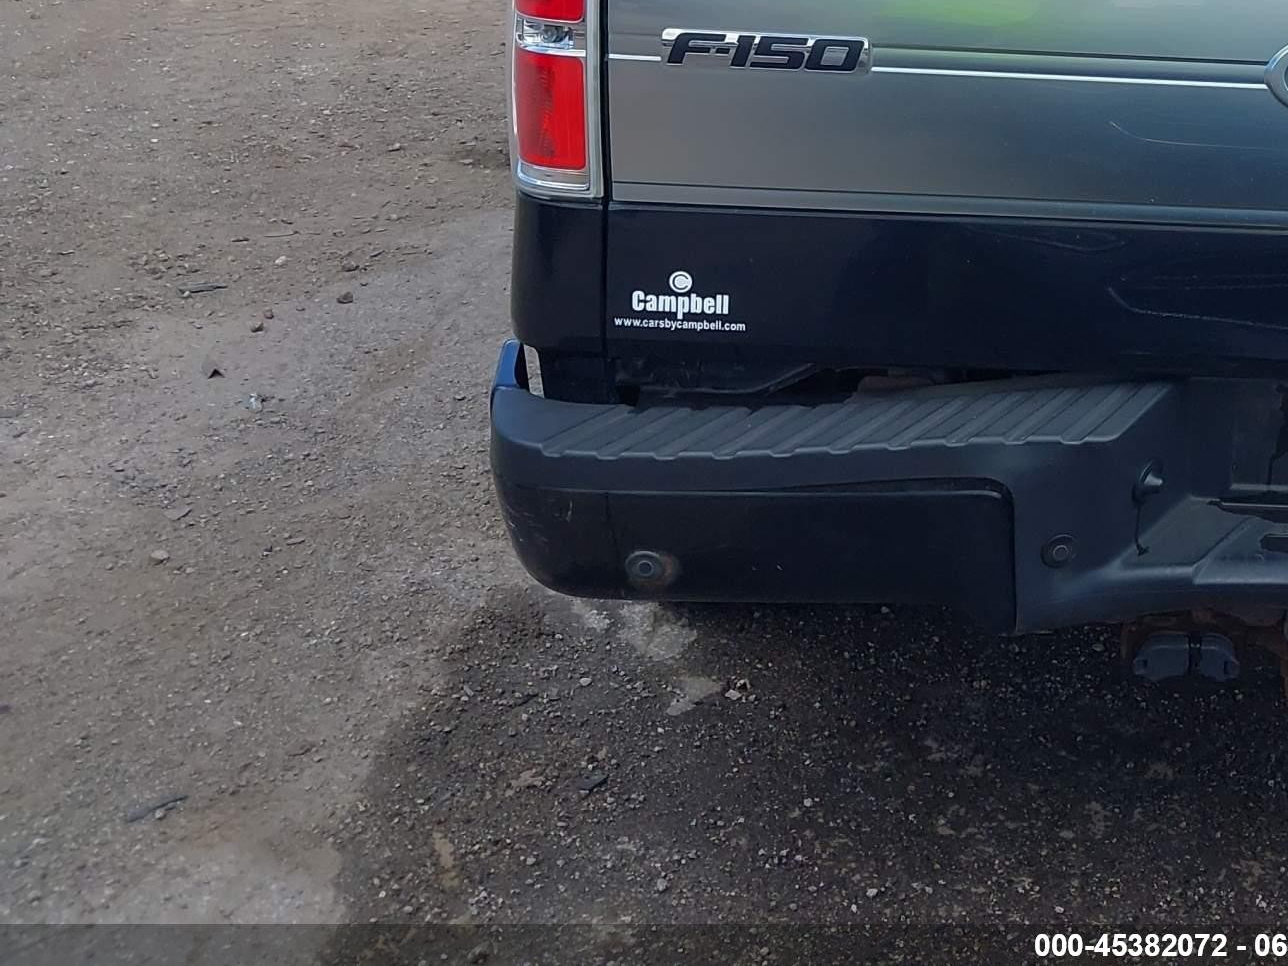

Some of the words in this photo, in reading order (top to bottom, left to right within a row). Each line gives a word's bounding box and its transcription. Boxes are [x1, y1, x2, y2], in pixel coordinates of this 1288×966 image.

[666, 31, 865, 72] F-150
[631, 290, 730, 320] Campbell
[614, 316, 747, 332] www.carsbycampbell.com
